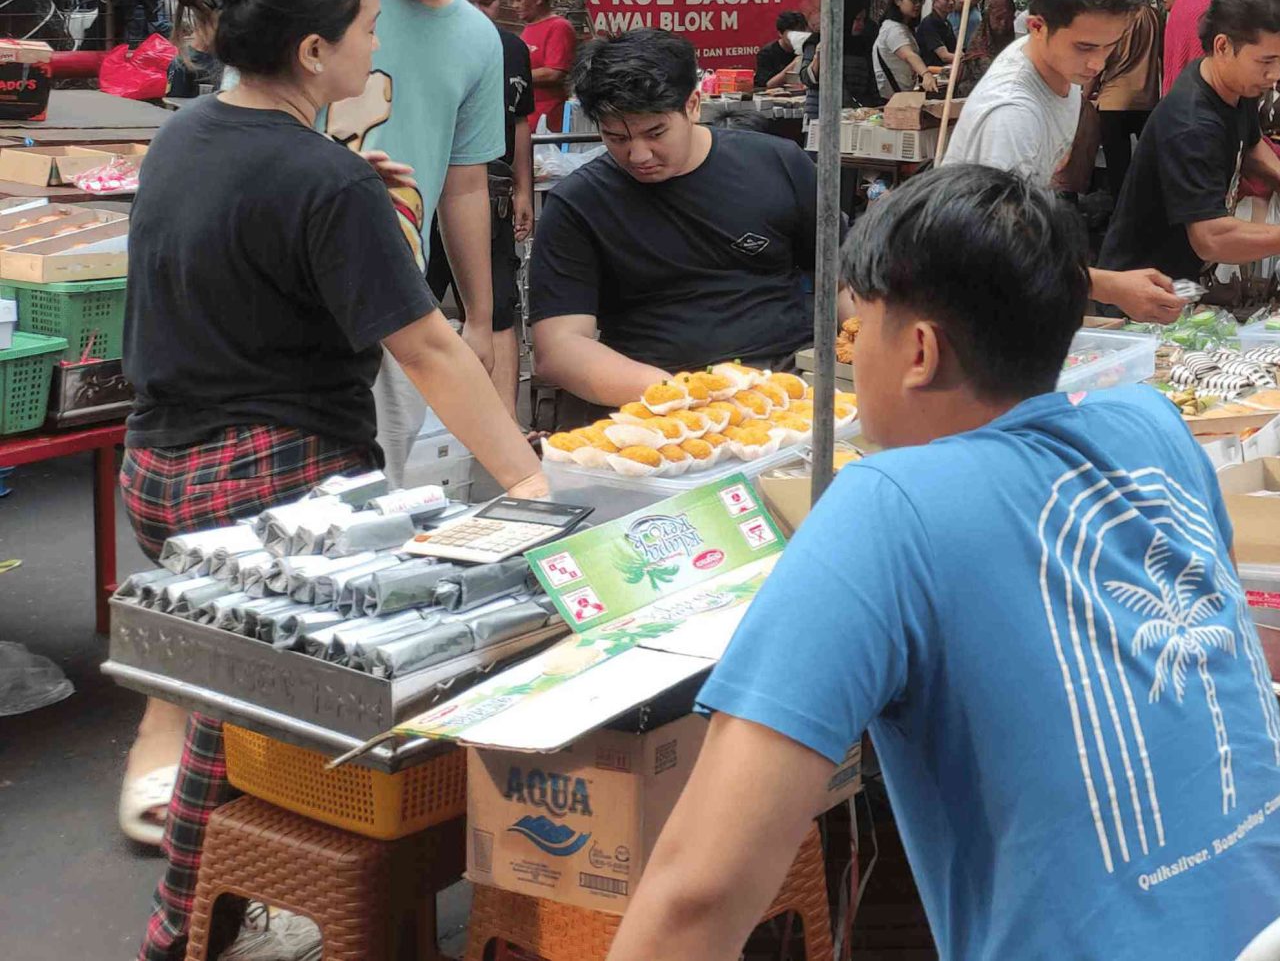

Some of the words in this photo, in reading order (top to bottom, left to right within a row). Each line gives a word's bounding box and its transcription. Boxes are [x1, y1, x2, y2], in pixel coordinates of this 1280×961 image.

[660, 11, 713, 31] BLOK
[721, 9, 739, 30] M
[703, 48, 723, 57] DAN
[726, 45, 760, 56] KERING
[503, 766, 593, 818] AQUA
